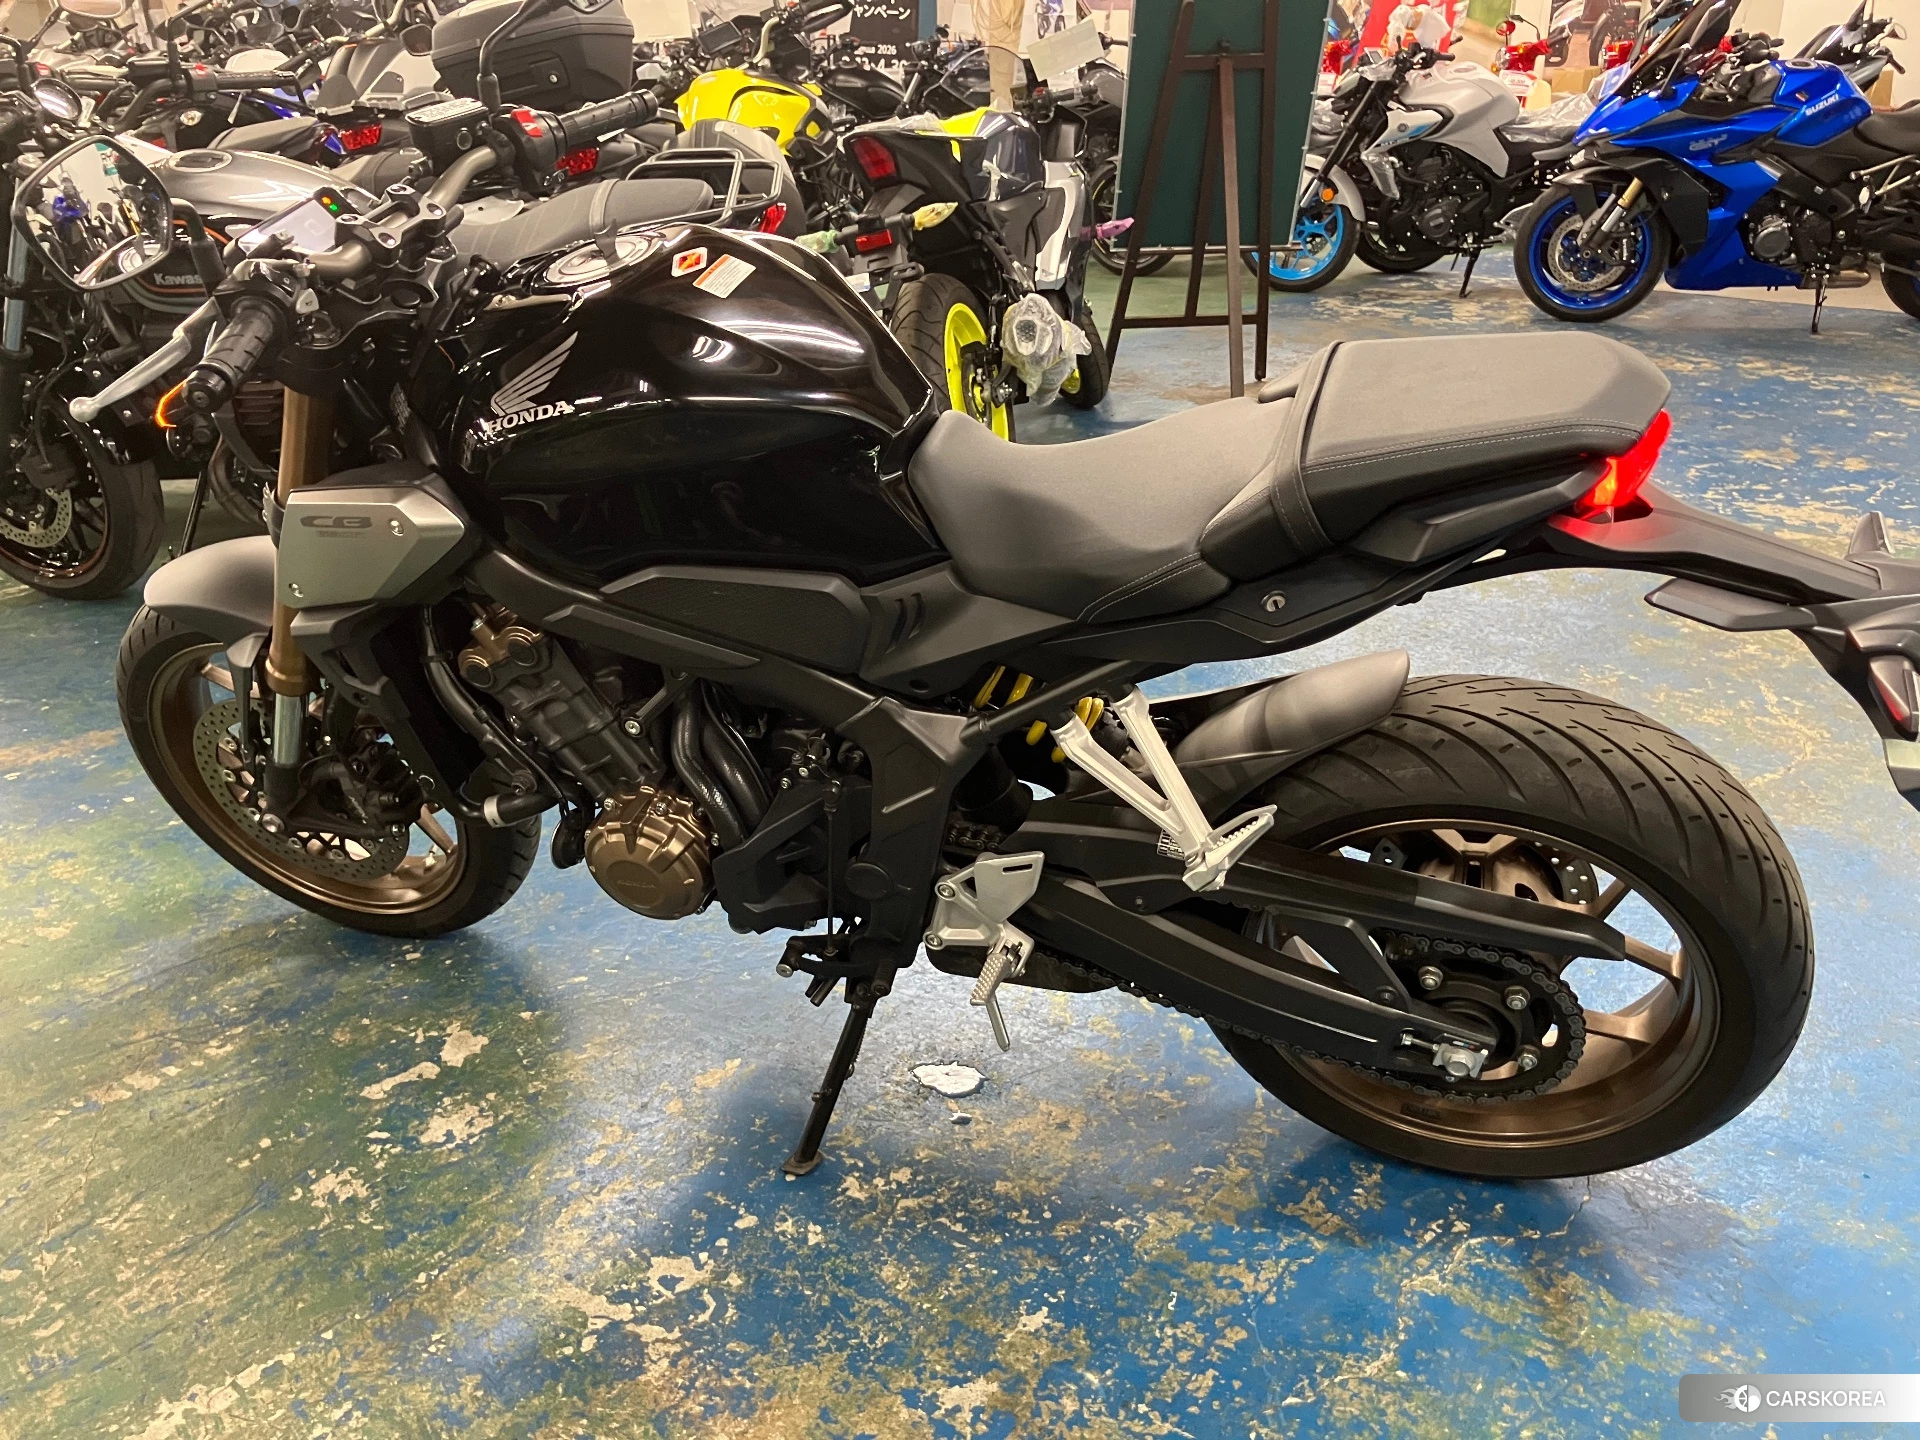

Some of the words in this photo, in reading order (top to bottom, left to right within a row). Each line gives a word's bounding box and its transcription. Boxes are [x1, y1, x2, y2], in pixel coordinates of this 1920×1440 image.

[853, 4, 911, 20] ャンペーン
[1805, 93, 1839, 116] SUZUKI
[153, 273, 204, 285] Kawas
[487, 400, 575, 435] HONDA
[300, 515, 373, 529] CB
